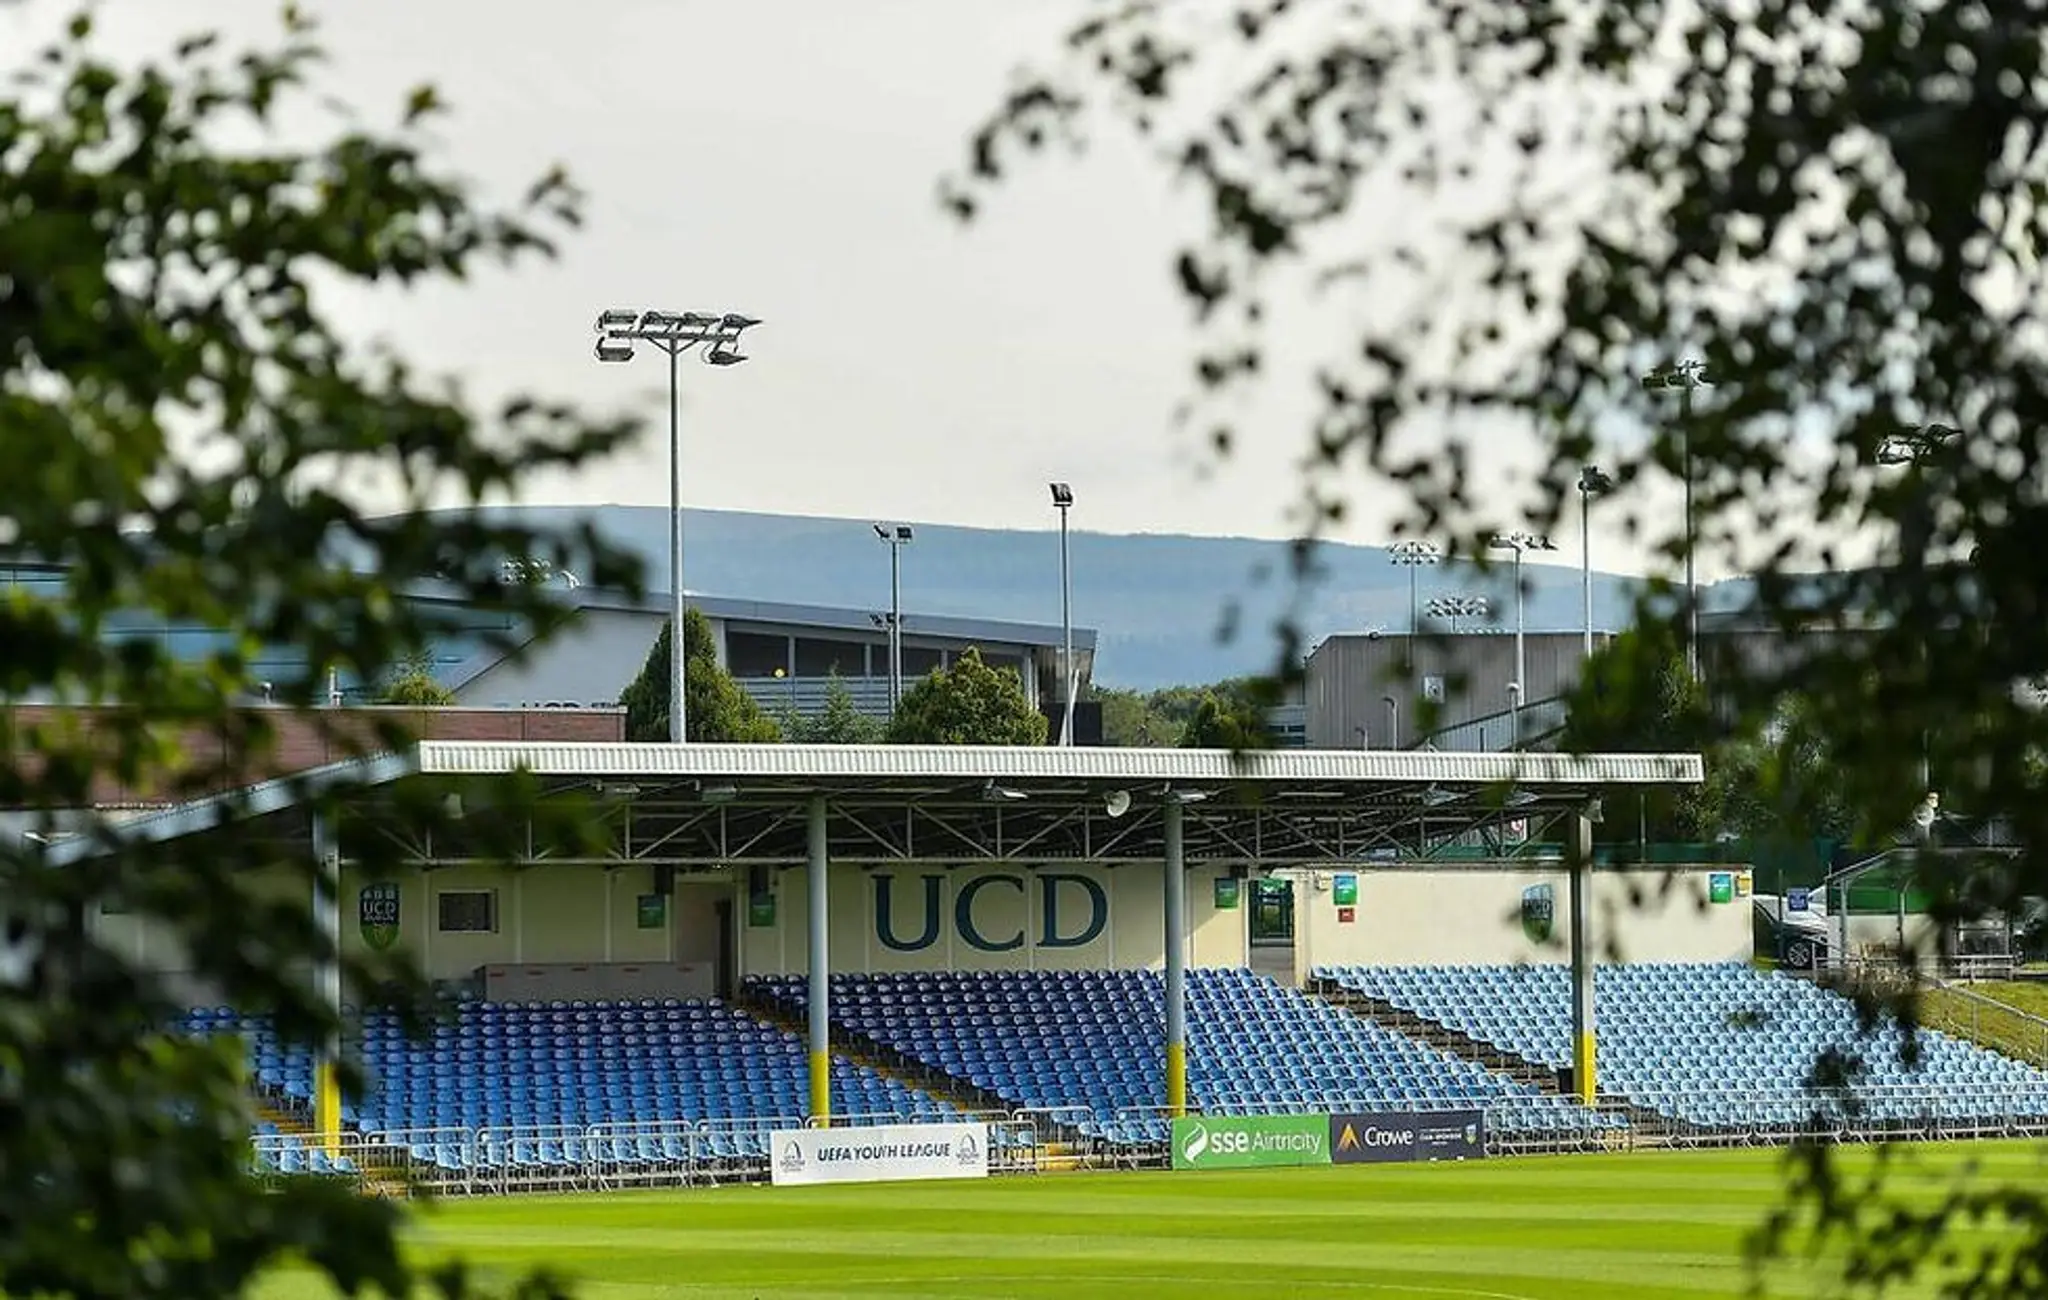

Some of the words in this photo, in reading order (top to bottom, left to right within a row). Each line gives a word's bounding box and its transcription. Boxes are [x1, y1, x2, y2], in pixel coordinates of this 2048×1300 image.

[363, 900, 397, 915] UCD
[870, 873, 1108, 952] UCD
[1210, 1131, 1250, 1153] sse
[1252, 1130, 1321, 1155] Airtricity
[1364, 1126, 1414, 1147] Crowe
[817, 1146, 851, 1162] UEFA
[853, 1144, 898, 1161] YOUTH
[900, 1142, 952, 1158] LEAGUE
